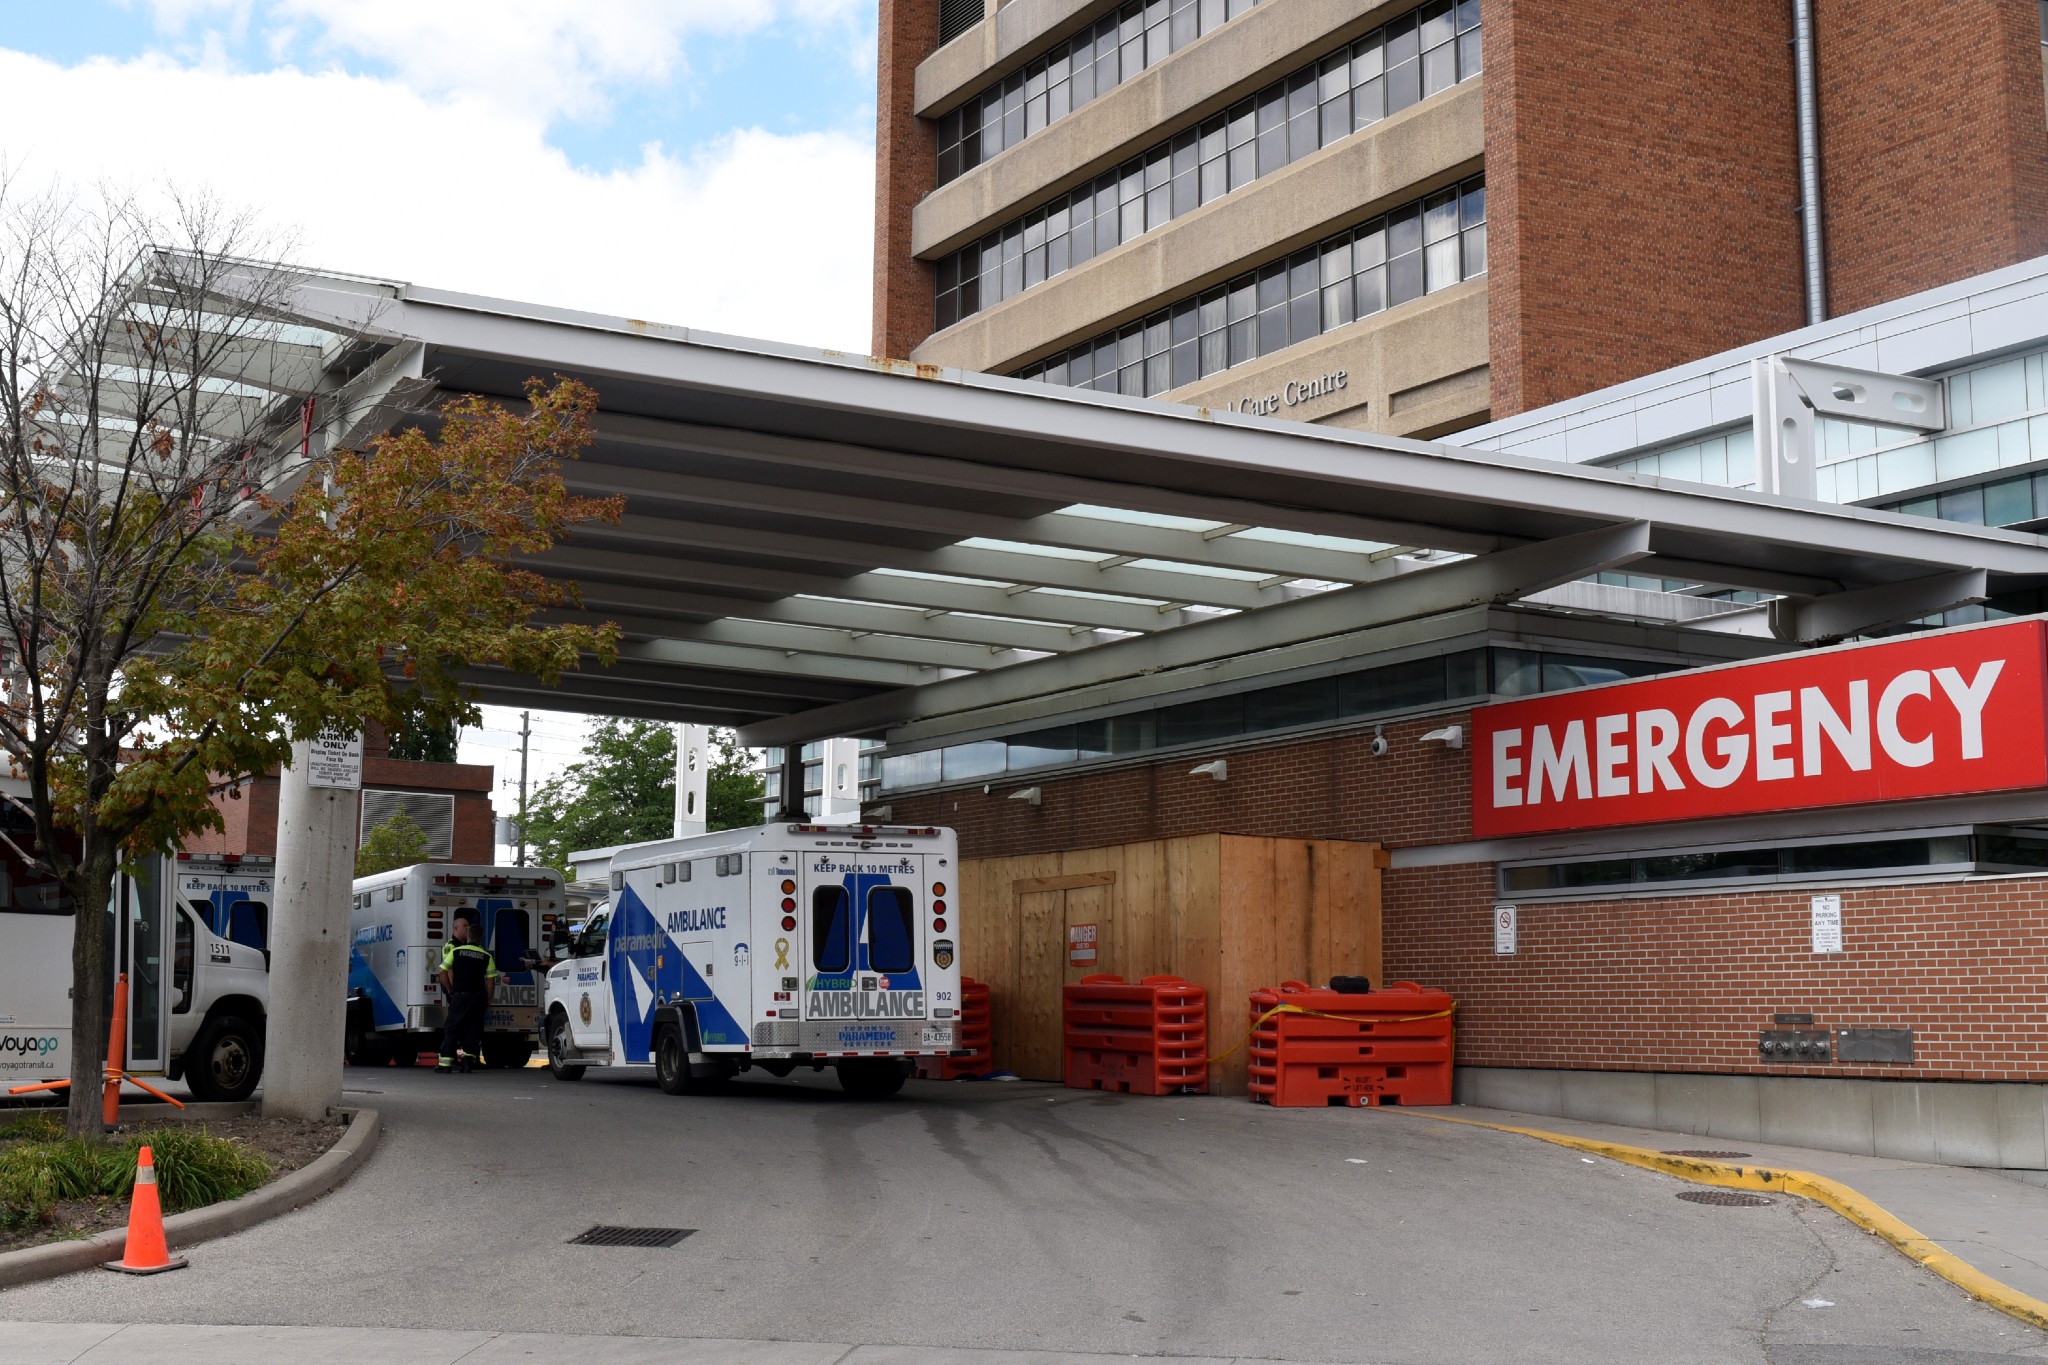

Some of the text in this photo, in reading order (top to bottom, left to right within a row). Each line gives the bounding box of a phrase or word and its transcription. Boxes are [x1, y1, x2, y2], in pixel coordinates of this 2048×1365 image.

[1238, 369, 1348, 416] Care Centre
[1492, 659, 2006, 808] EMERGENCY
[323, 741, 348, 749] ONLY
[814, 863, 915, 874] KEEP BACK 10 METRES
[667, 906, 726, 933] AMBULANCE
[1071, 926, 1096, 942] DANGER
[613, 926, 667, 958] paramedic
[210, 943, 230, 954] 1511
[577, 972, 599, 982] PARAMEDIC
[816, 978, 857, 989] HYBRID
[936, 992, 952, 1000] 902
[809, 991, 925, 1017] AMBULANCE
[838, 1031, 896, 1041] PARAMEDIC
